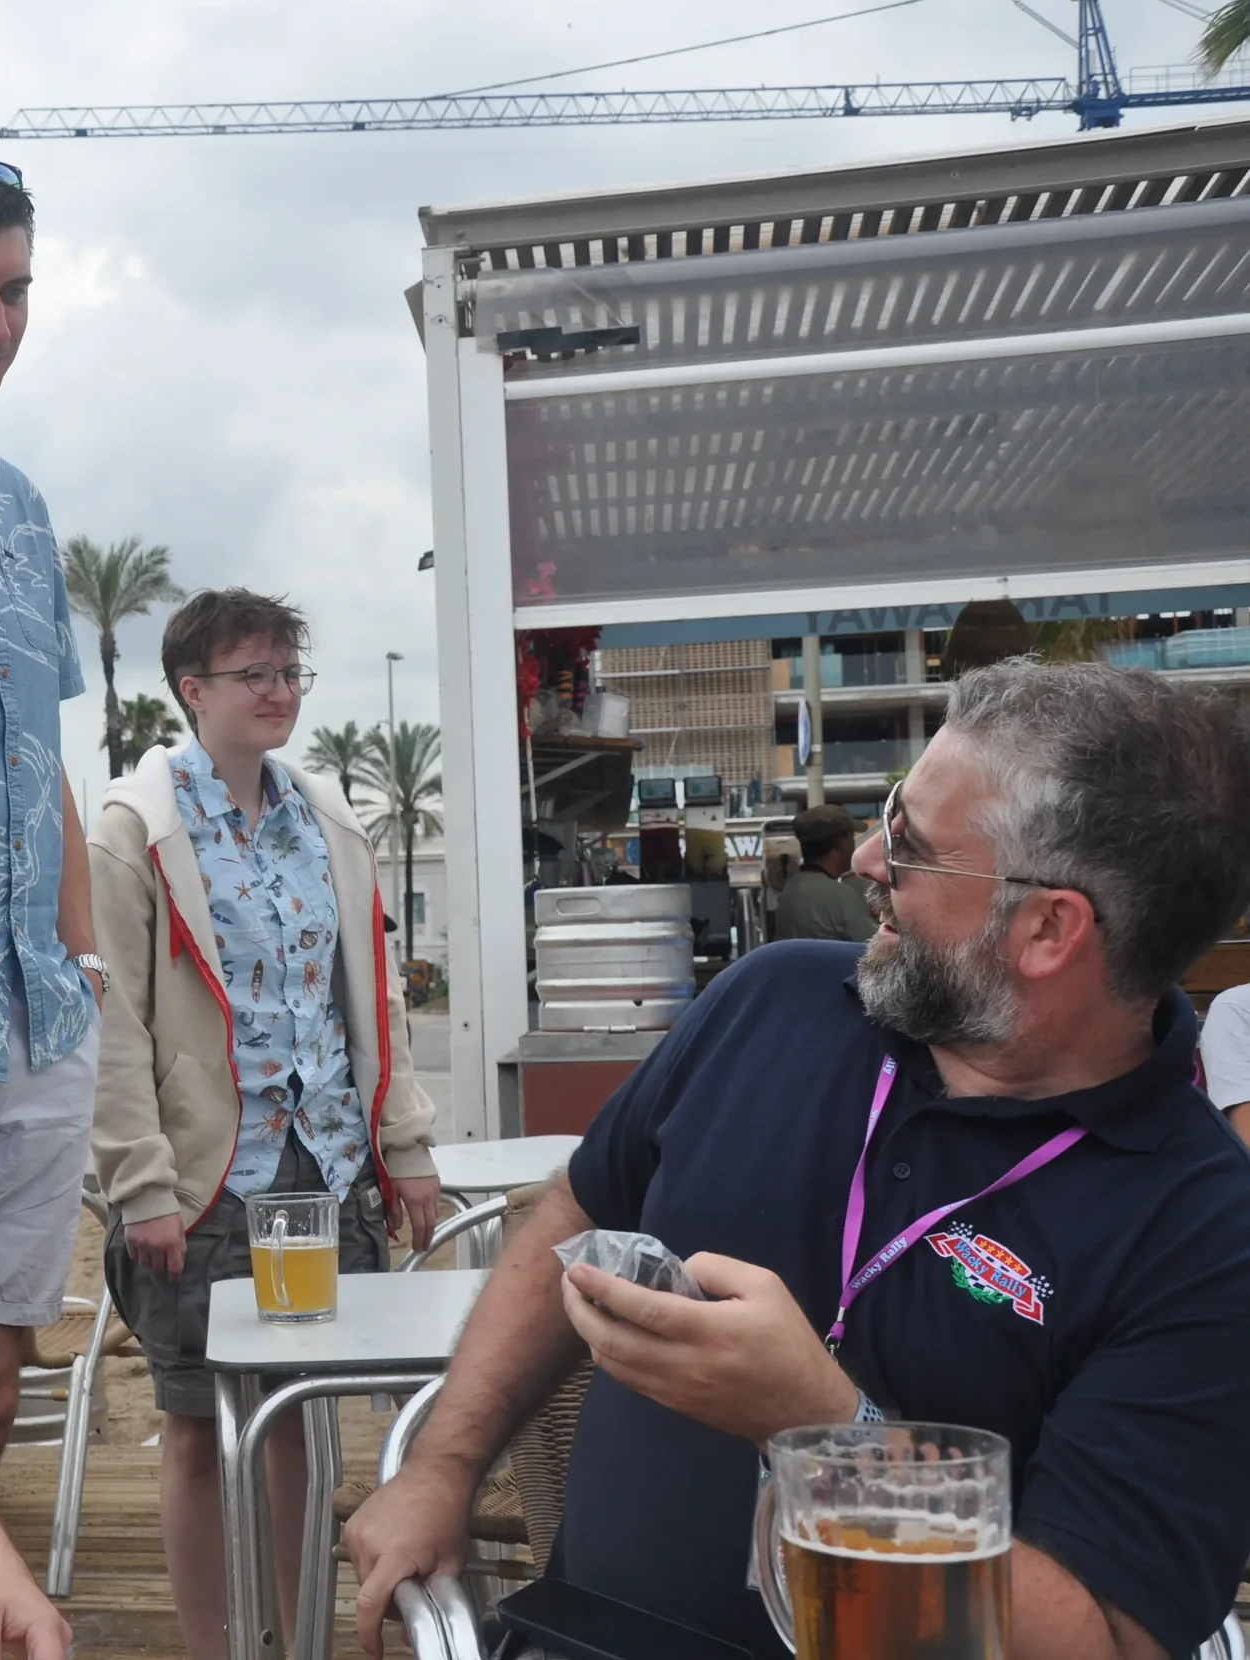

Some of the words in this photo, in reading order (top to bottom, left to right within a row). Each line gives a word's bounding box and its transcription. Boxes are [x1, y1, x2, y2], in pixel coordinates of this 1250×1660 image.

[852, 1261, 883, 1289] Wacky
[879, 1237, 908, 1263] Rally
[954, 1240, 989, 1275] Wacky
[990, 1268, 1027, 1298] Rally
